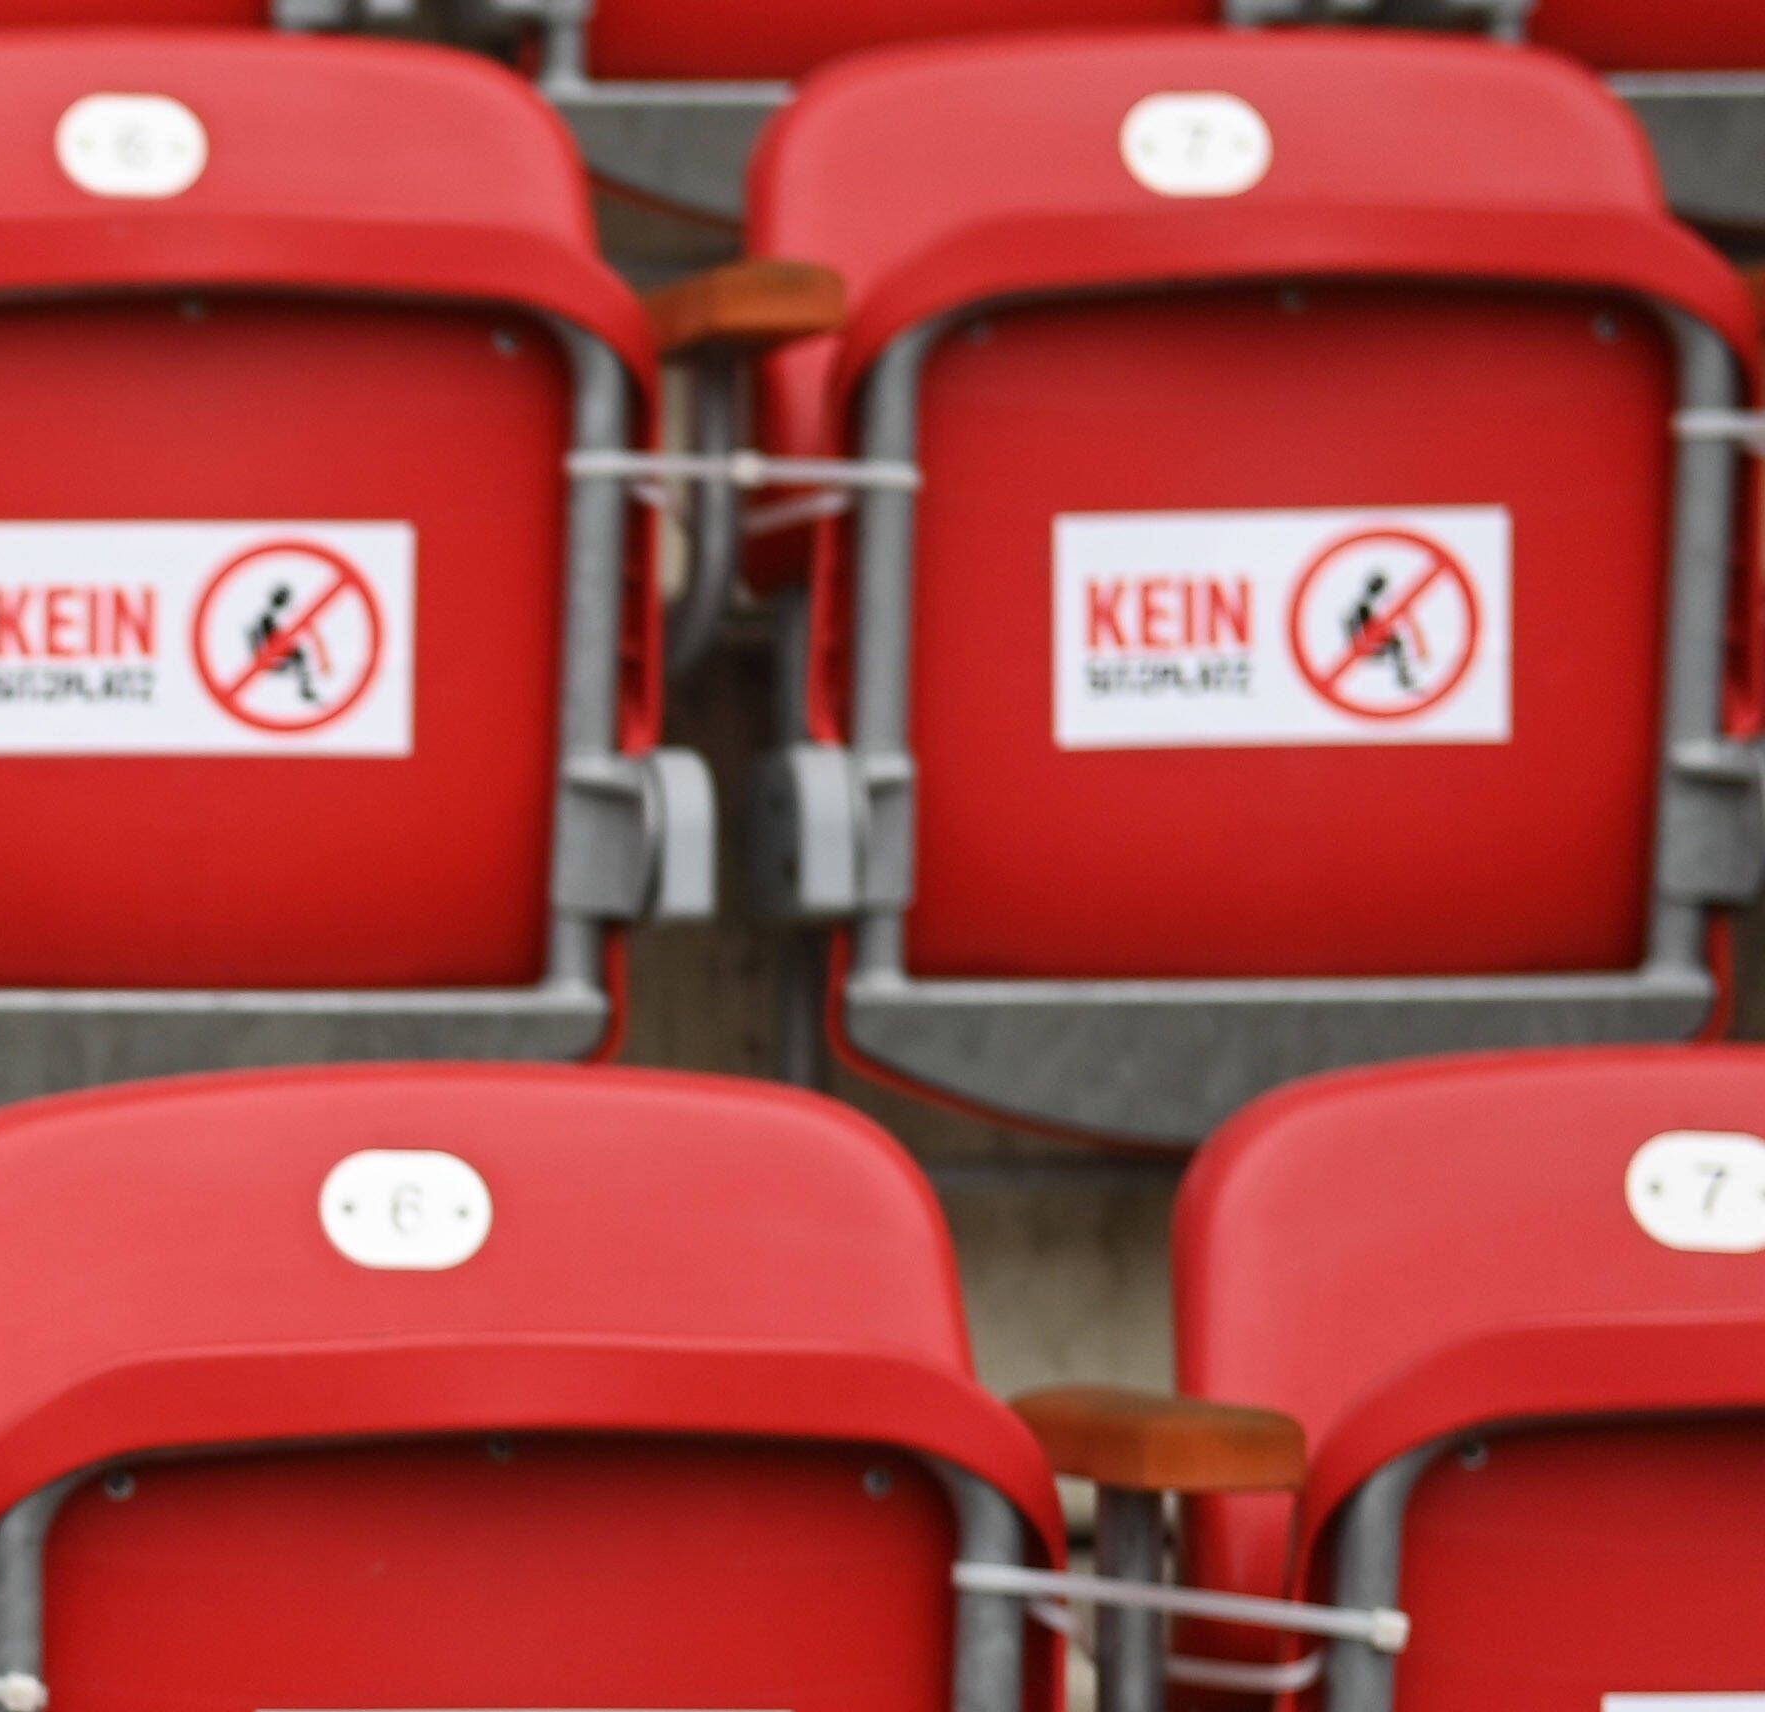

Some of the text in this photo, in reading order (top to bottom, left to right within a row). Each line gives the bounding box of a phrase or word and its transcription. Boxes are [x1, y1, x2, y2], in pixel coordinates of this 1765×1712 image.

[1086, 577, 1252, 650] KEIN
[389, 1180, 423, 1233] 6
[1696, 1161, 1730, 1217] 7
